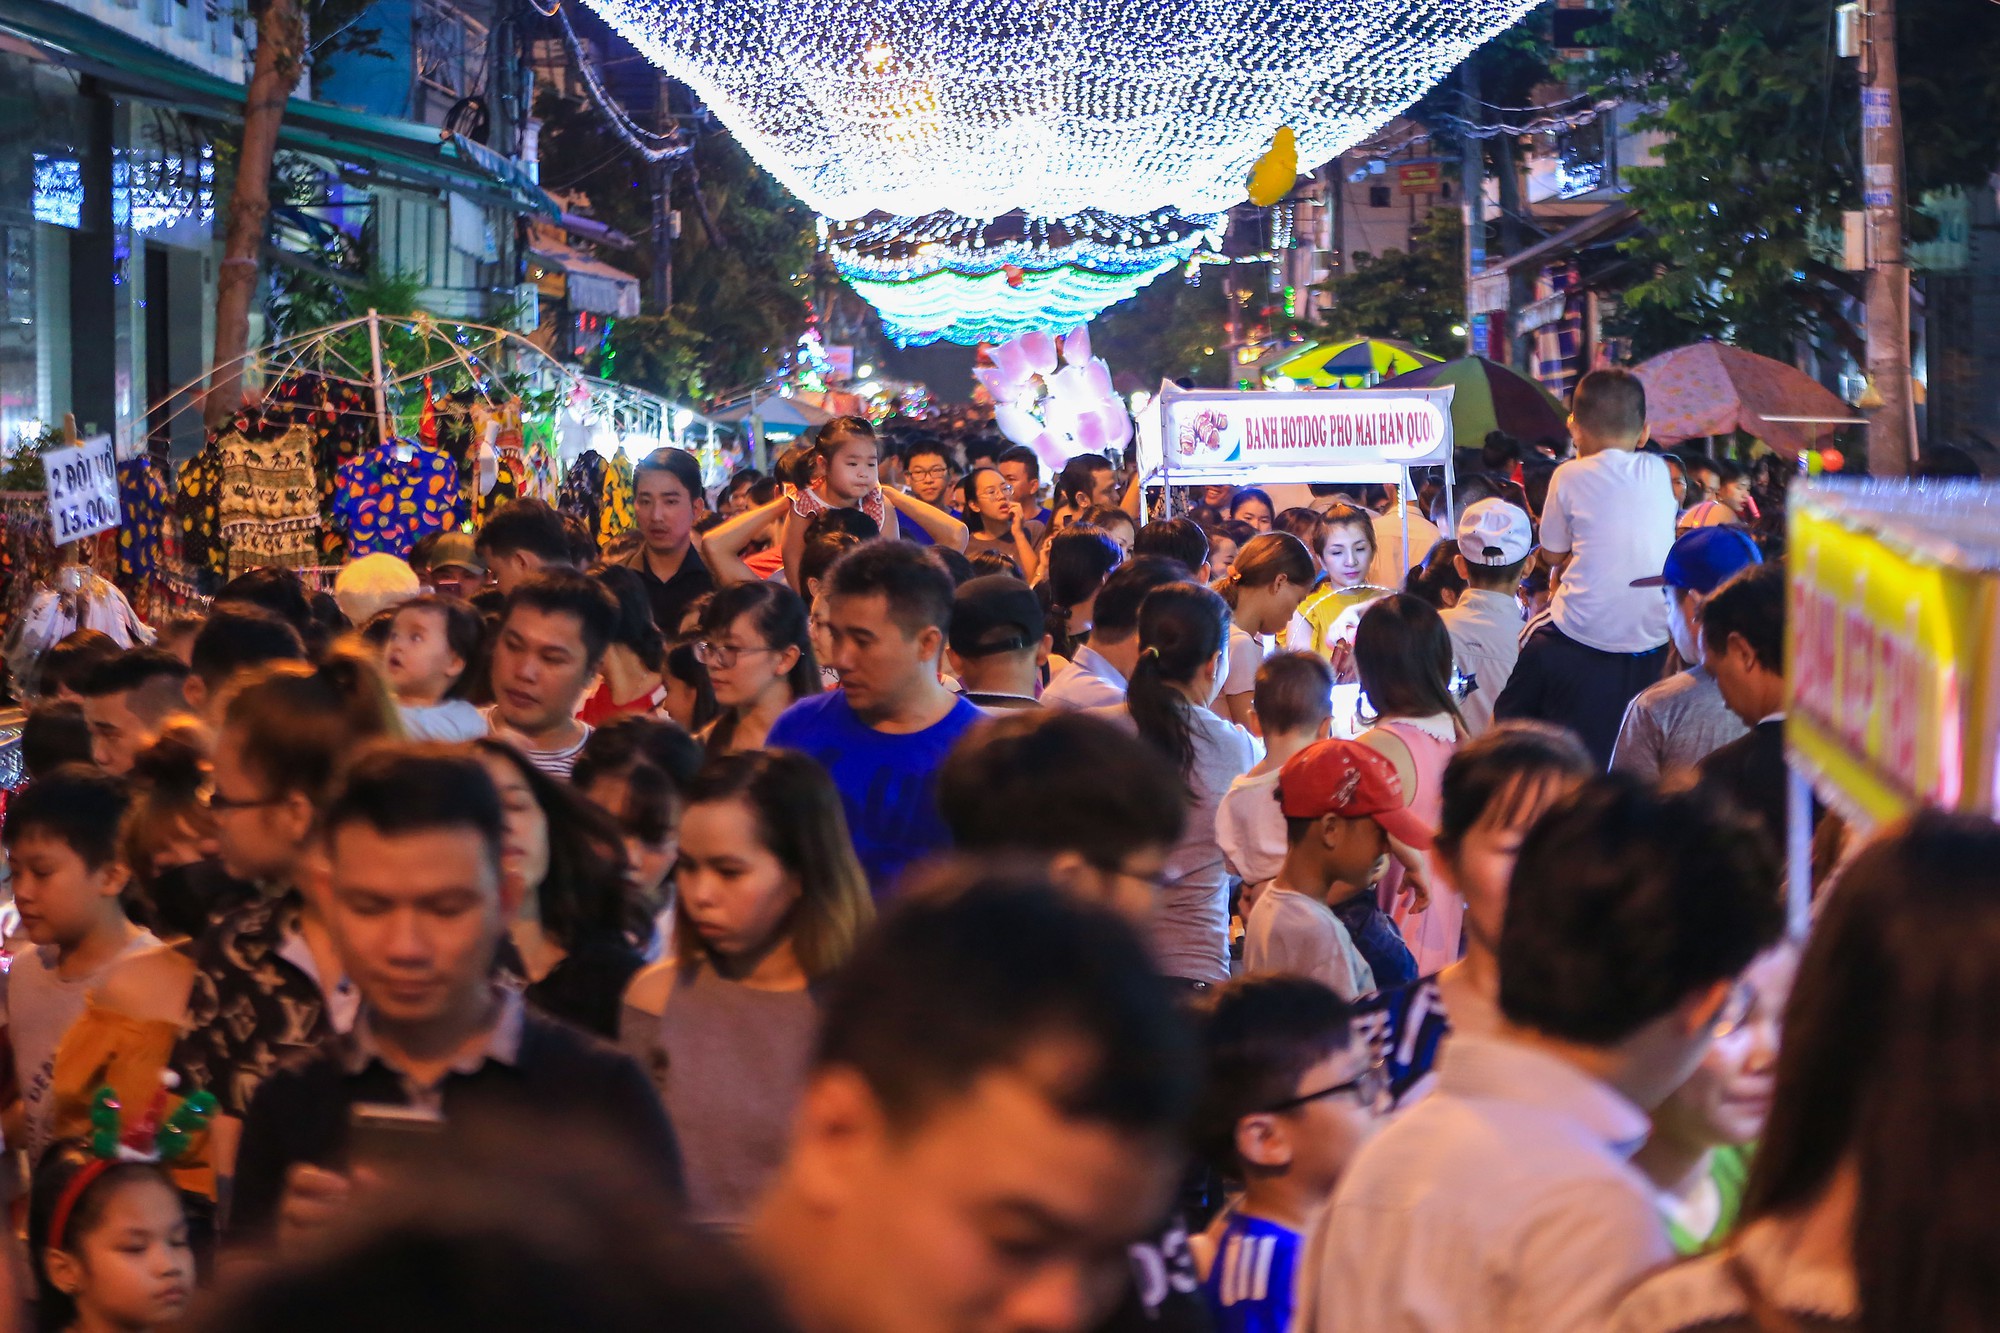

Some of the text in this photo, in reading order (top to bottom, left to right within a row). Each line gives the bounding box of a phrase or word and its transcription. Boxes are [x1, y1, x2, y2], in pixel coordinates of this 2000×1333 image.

[1281, 414, 1327, 449] HOTDOG
[1355, 412, 1377, 446] MAI
[52, 468, 64, 500] 2
